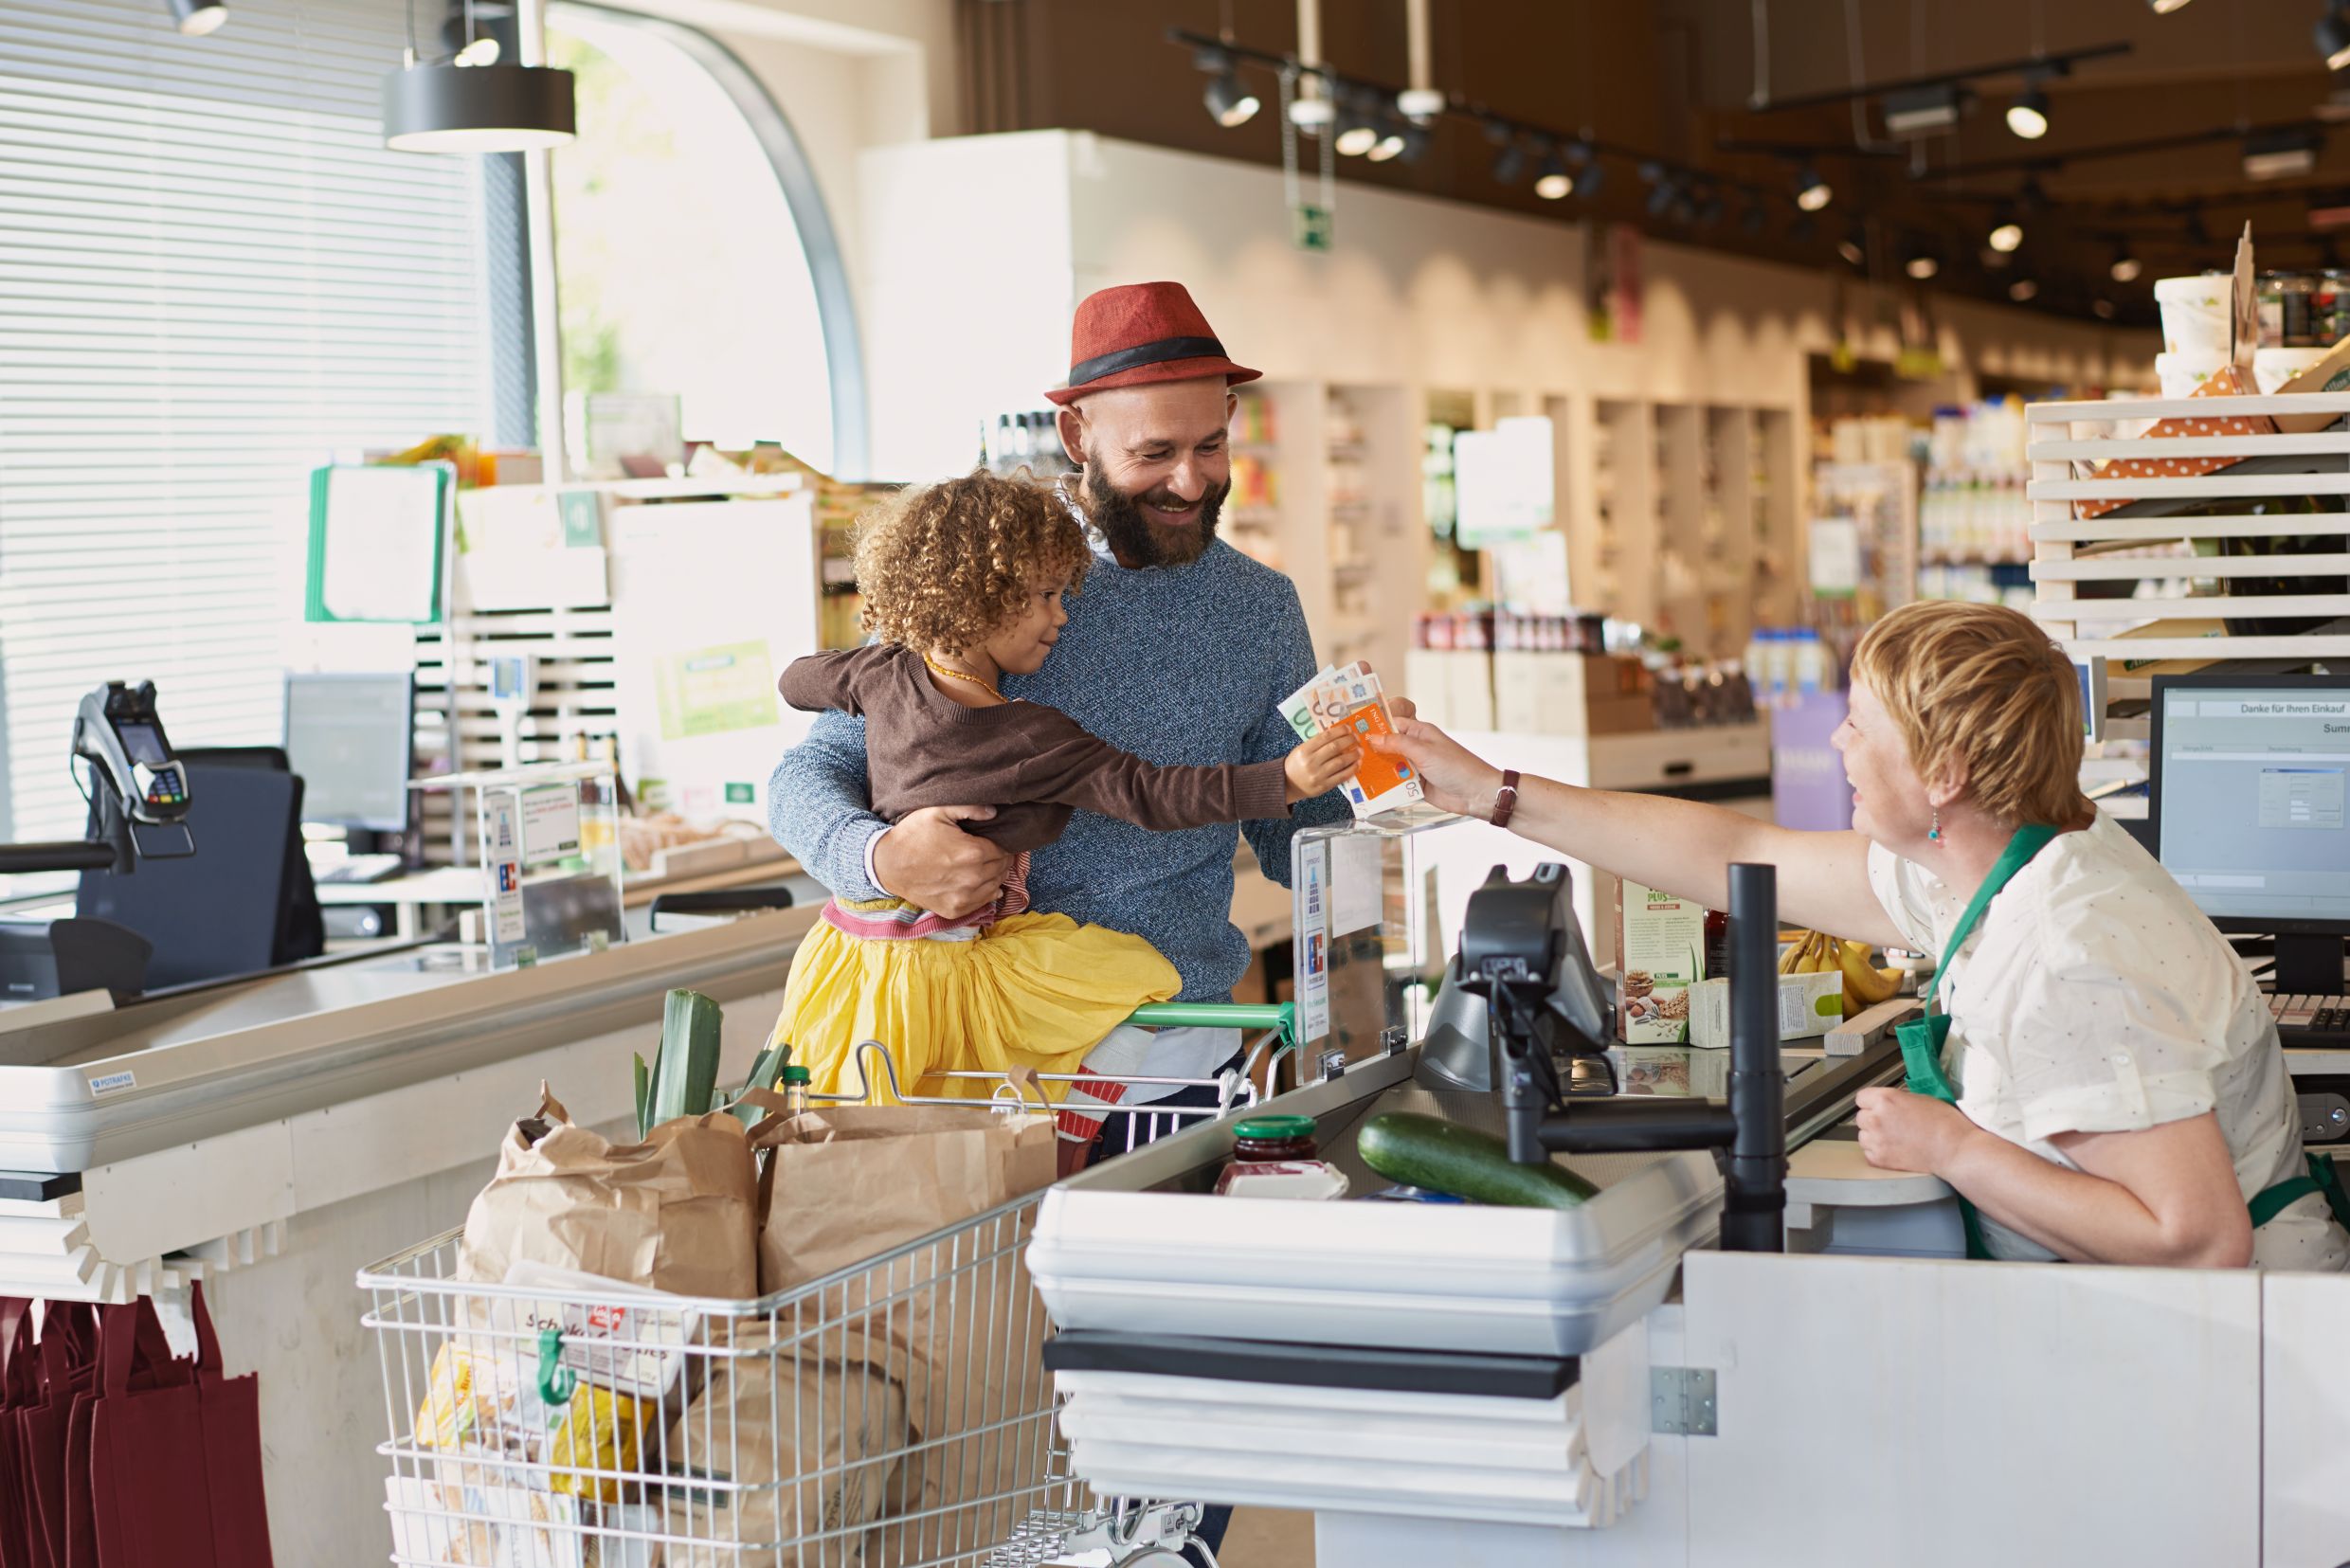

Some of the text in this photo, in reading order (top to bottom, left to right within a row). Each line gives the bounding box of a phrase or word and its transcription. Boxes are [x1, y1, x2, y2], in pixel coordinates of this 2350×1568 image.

[2241, 704, 2345, 713] Danke für Ihren Einkauf
[2323, 723, 2350, 733] Sum
[1405, 781, 1420, 798] 50
[1647, 892, 1668, 902] PLUS
